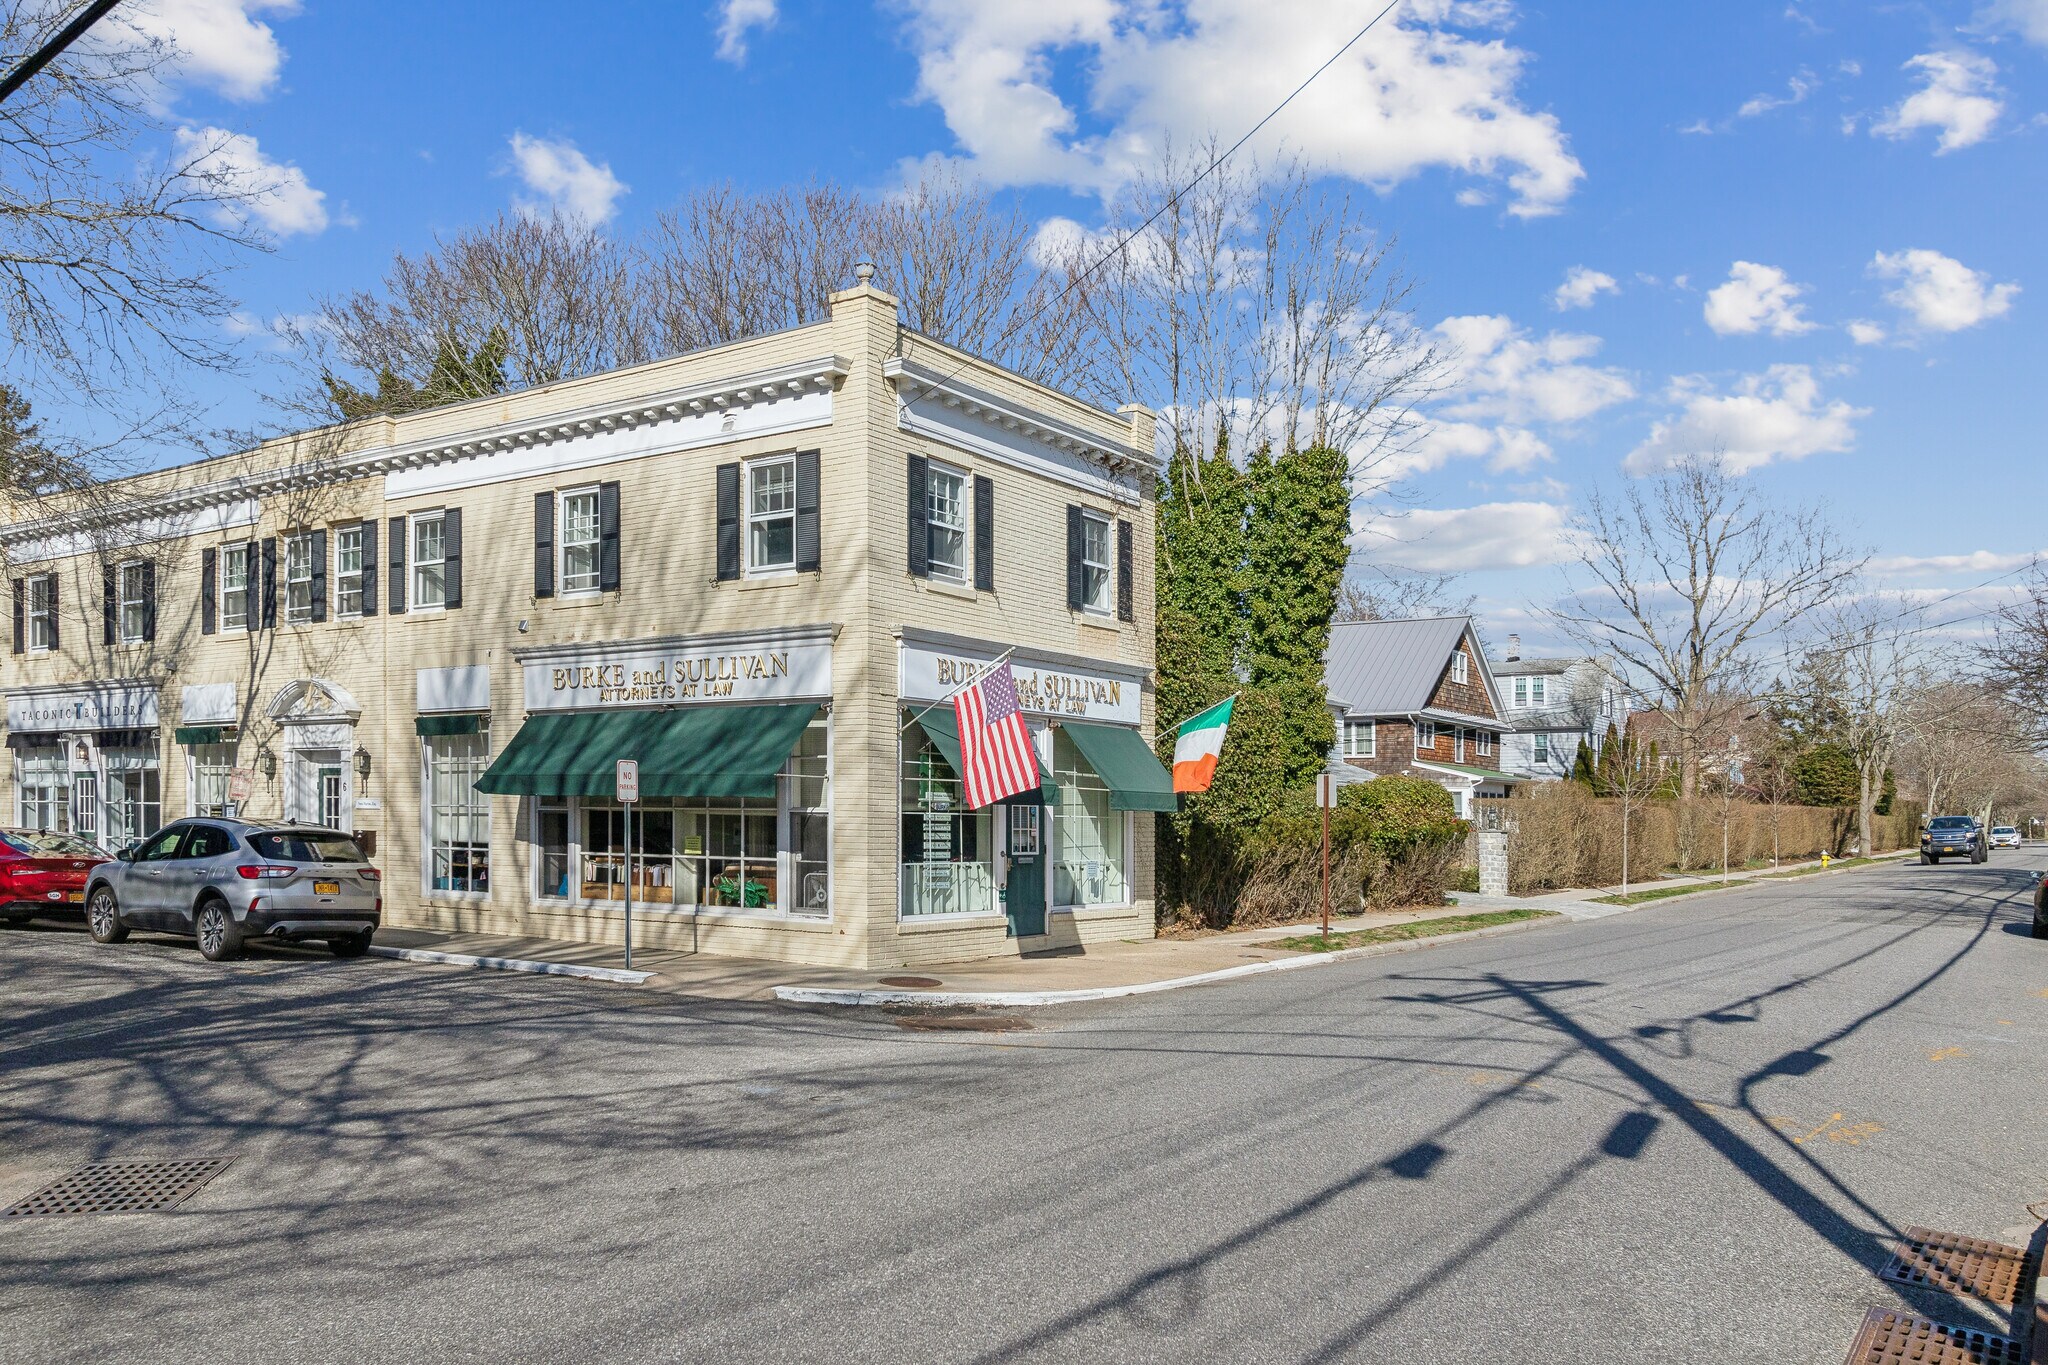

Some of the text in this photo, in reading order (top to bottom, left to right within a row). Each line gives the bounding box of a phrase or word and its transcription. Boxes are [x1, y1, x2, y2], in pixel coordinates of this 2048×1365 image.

[552, 652, 788, 691] BURKE and SULLIVAN
[600, 682, 733, 702] ATTORNEYS AT LAW
[1044, 674, 1120, 707] SULLIVAN
[21, 708, 72, 721] TACONIC
[84, 704, 143, 718] BUILDERS
[1049, 697, 1061, 712] AT
[1065, 699, 1087, 716] LAW
[623, 771, 632, 780] NO
[342, 782, 347, 792] 6
[619, 783, 637, 791] PARKING
